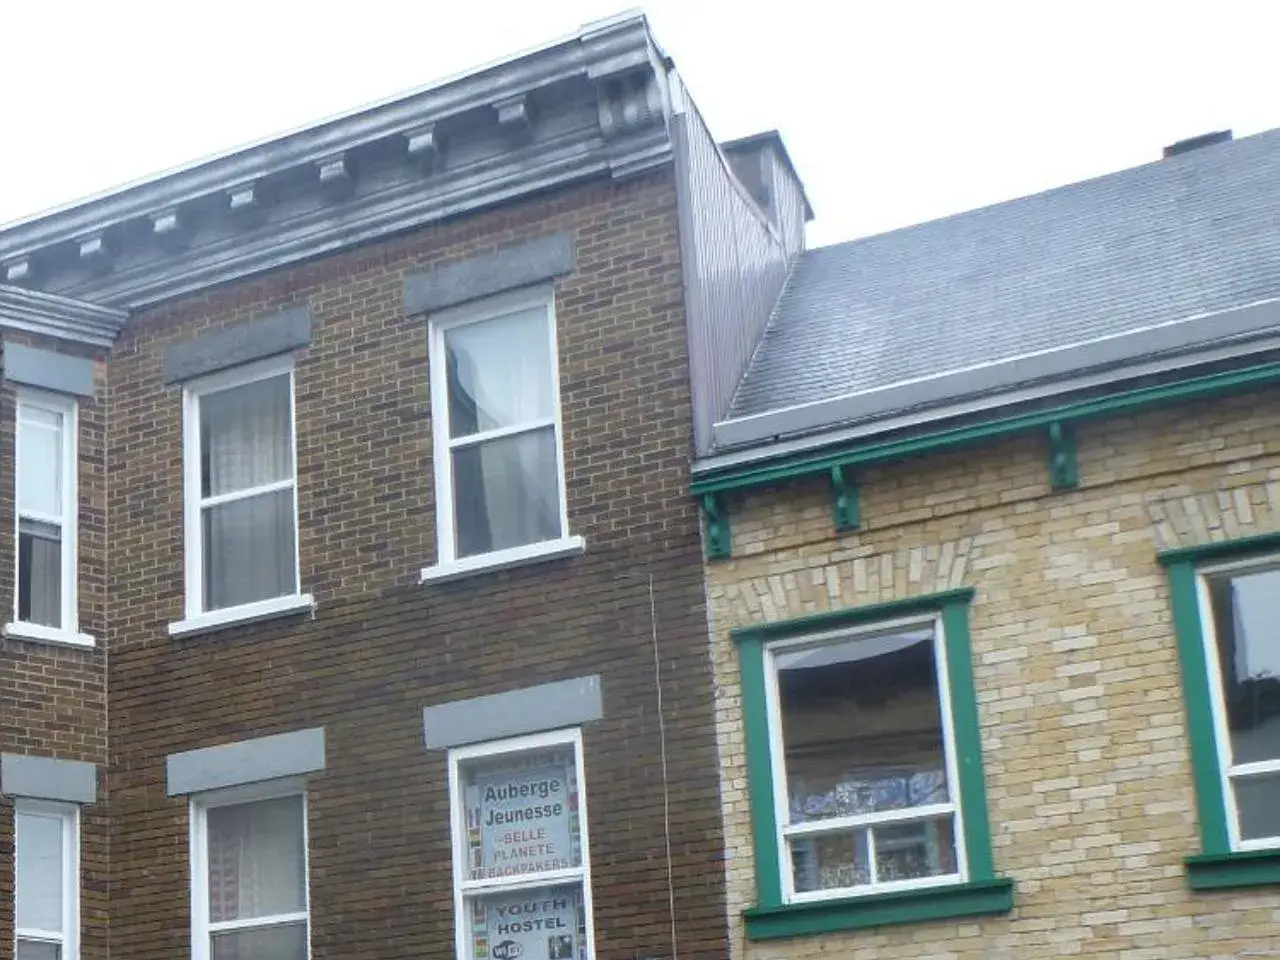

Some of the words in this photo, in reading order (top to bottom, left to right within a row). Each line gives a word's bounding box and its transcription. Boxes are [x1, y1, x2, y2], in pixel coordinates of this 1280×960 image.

[484, 777, 561, 803] Auberge
[484, 803, 563, 827] Jeunesse
[496, 897, 567, 918] YOUTH
[497, 917, 567, 936] HOSTEL
